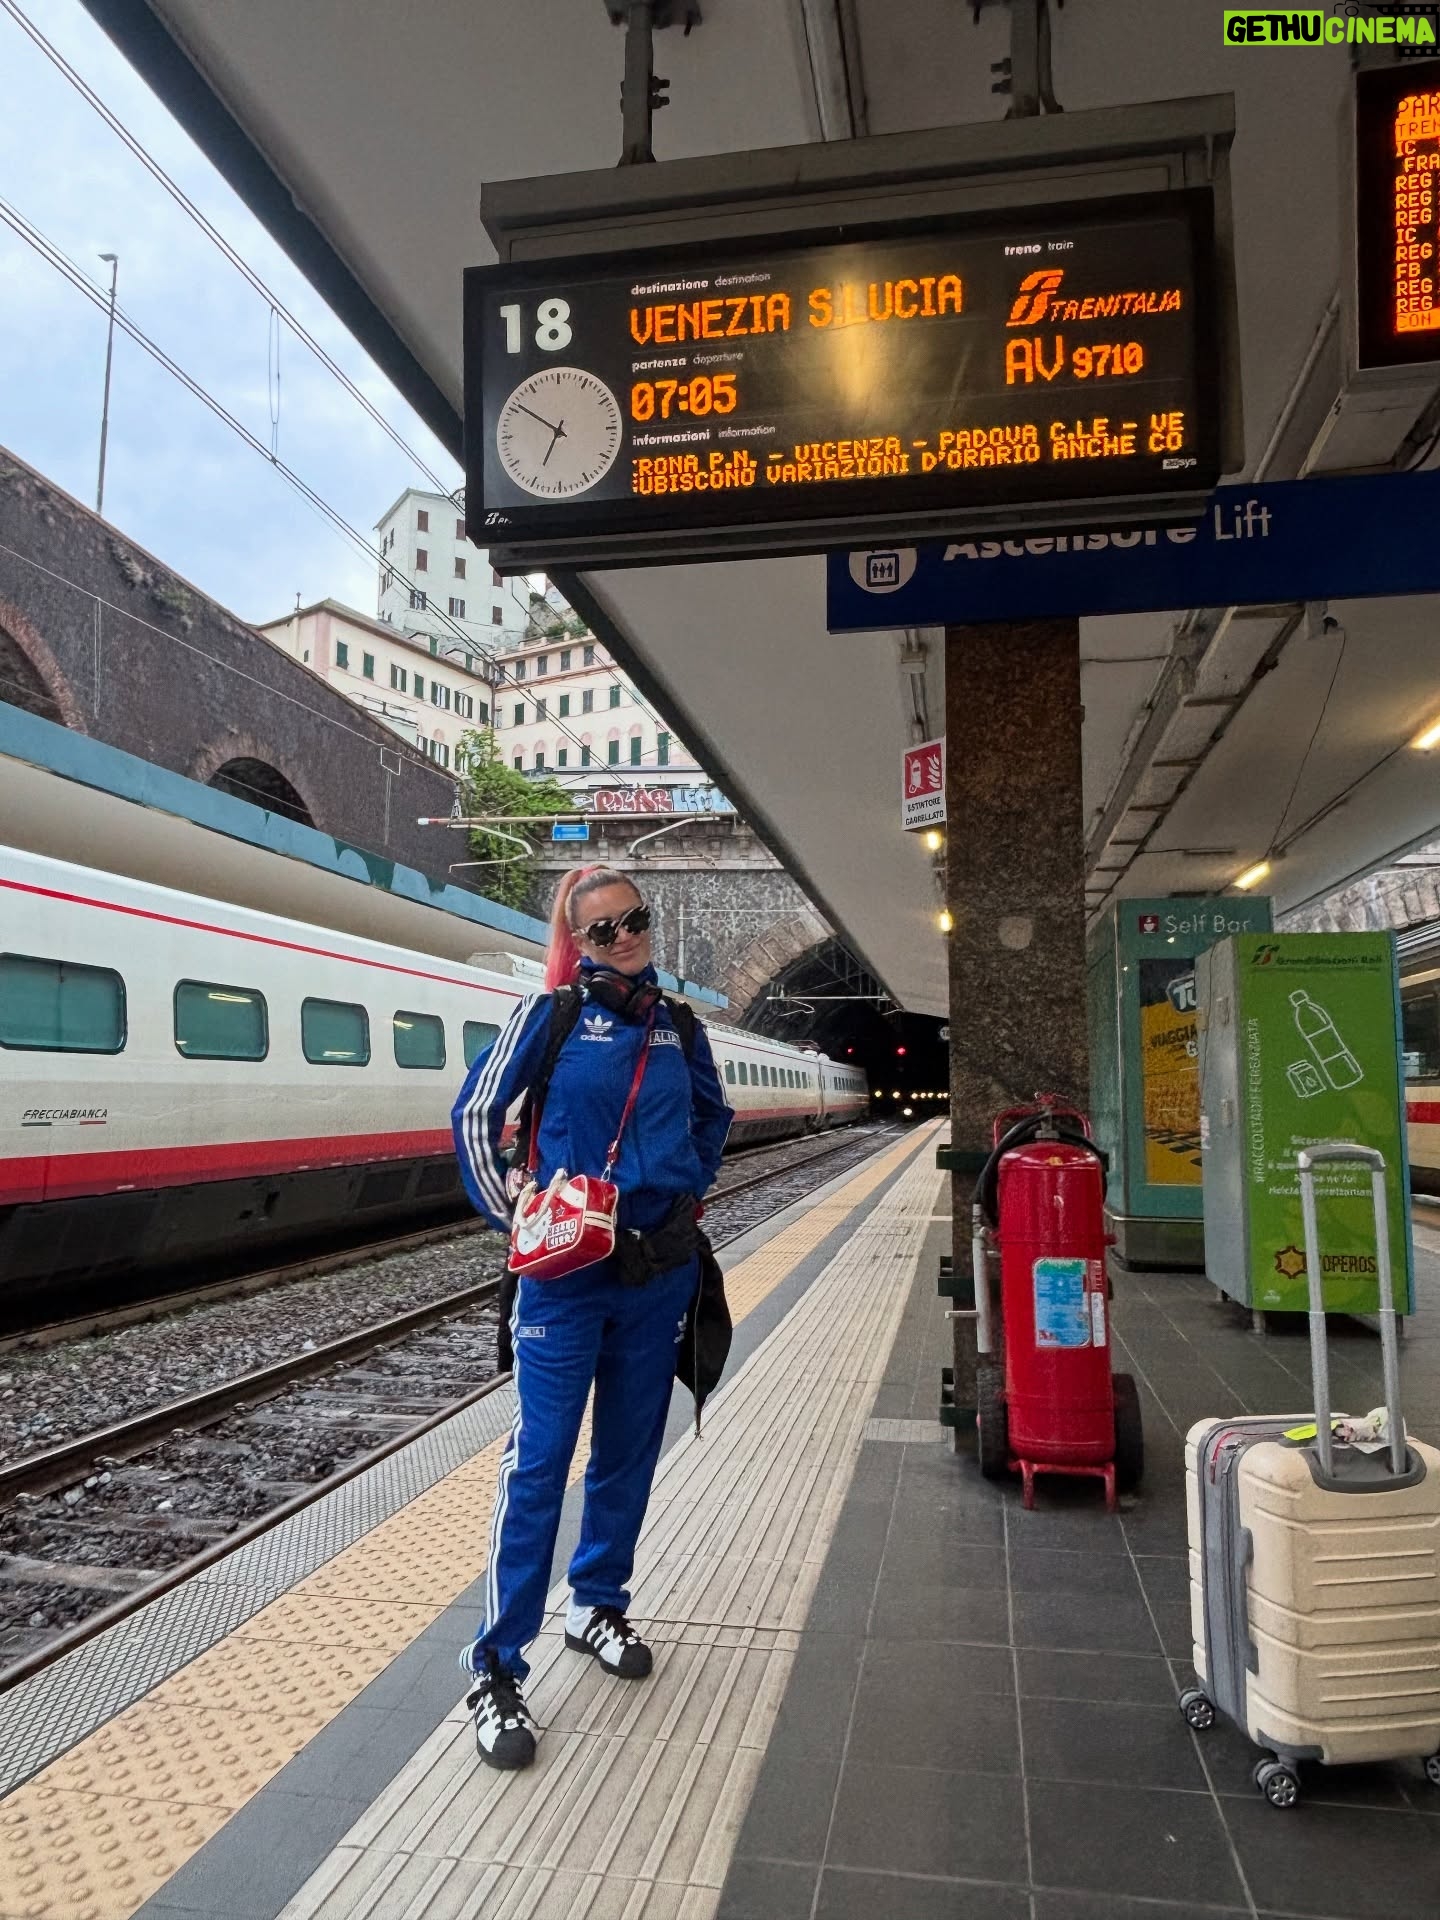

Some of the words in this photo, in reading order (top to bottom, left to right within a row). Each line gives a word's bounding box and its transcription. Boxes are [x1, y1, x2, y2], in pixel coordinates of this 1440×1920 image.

[1396, 172, 1432, 191] REG
[1396, 190, 1432, 209] REG
[1396, 208, 1432, 226] REG
[1396, 227, 1417, 243] IC
[1004, 244, 1042, 256] treno
[1396, 243, 1433, 261] REG
[631, 279, 709, 295] destinazione
[714, 273, 771, 287] destination
[1396, 278, 1433, 297] REG
[1050, 289, 1181, 322] TRENITALIA
[1396, 296, 1433, 313] REG
[500, 297, 573, 354] 18
[630, 293, 791, 345] VENEZIA
[631, 357, 686, 372] partenza
[692, 351, 744, 366] departure
[1006, 335, 1064, 385] AV
[1072, 342, 1144, 379] 9710
[631, 374, 738, 421] 07:05
[632, 431, 711, 447] informazioni
[718, 424, 776, 439] information
[709, 450, 758, 471] P.N.
[794, 437, 901, 463] VICENZA
[939, 424, 1038, 450] PADOVA
[1050, 417, 1109, 441] C.LE
[1151, 411, 1184, 433] VE
[766, 453, 912, 484] VARIAZIONI
[922, 444, 1041, 472] D'ORARIO
[1052, 434, 1136, 460] ANCHE
[1149, 432, 1183, 453] CO
[1215, 500, 1273, 541] Lift
[1164, 914, 1205, 934] Self
[1213, 915, 1250, 933] Bar
[580, 1033, 613, 1042] adidas
[22, 1108, 108, 1120] FRECCIABIANCA
